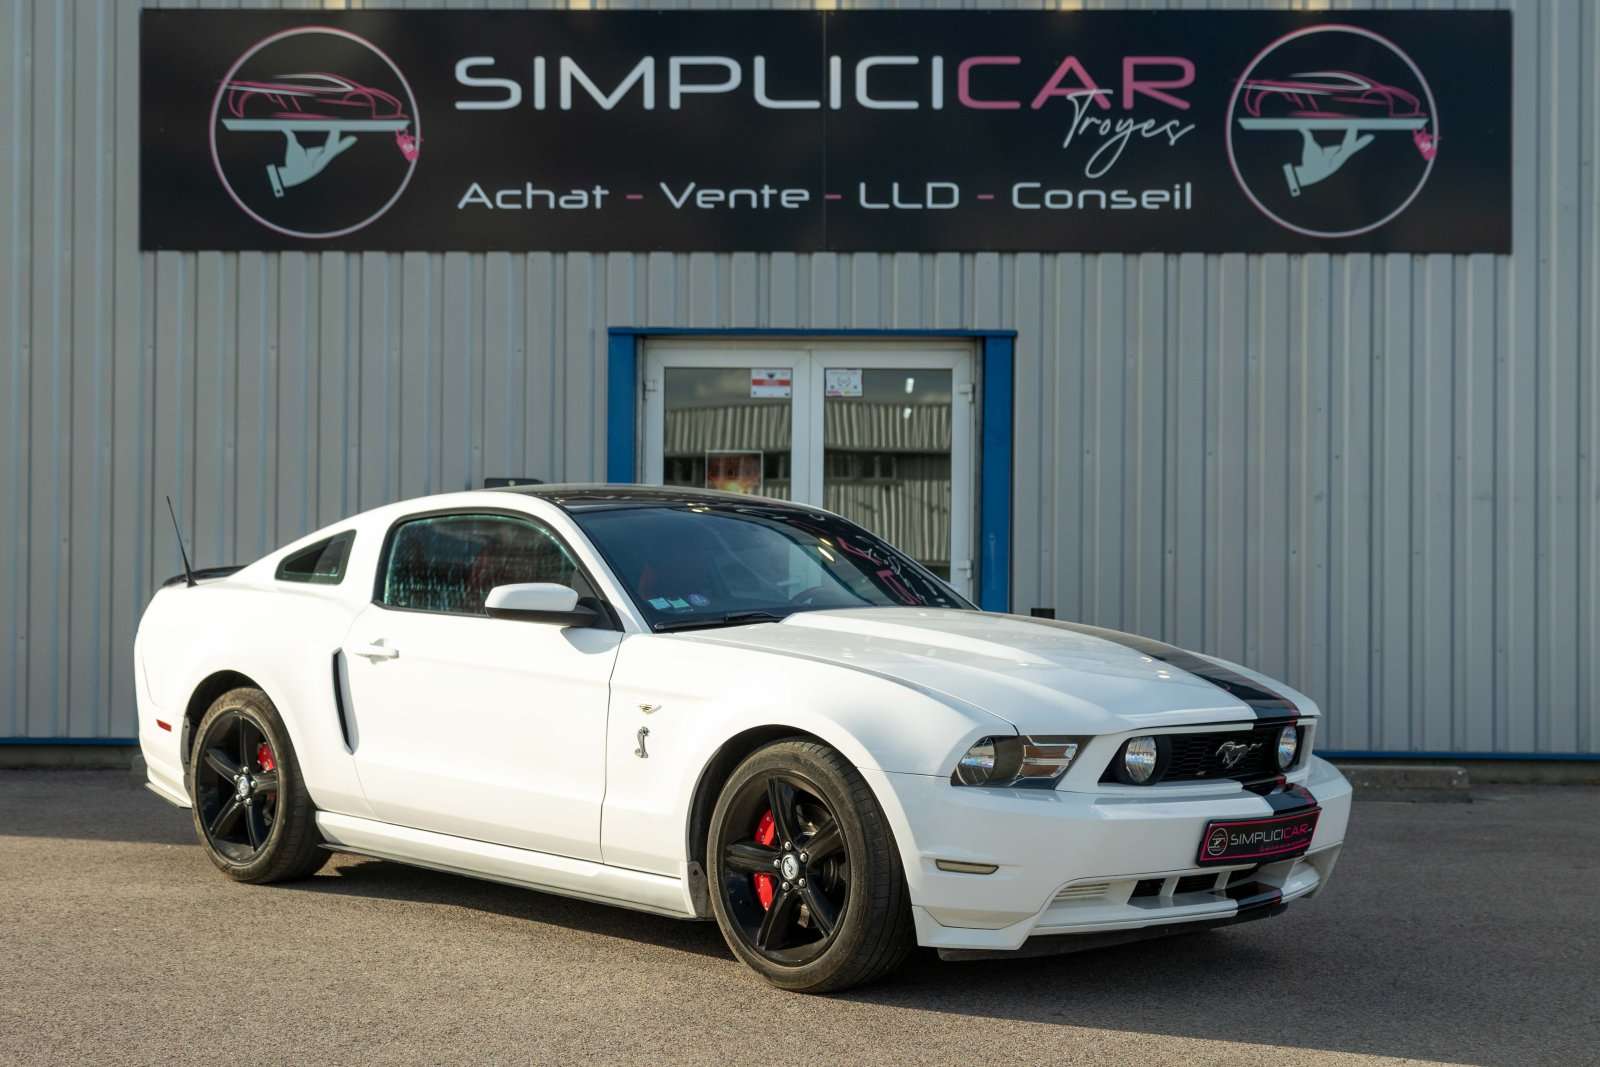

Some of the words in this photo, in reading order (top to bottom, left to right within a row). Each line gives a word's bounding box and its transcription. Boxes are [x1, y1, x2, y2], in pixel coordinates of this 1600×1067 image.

[454, 55, 1196, 110] SIMPLICICAR
[1062, 89, 1195, 178] Troyes
[457, 182, 610, 209] Achat
[659, 182, 811, 209] Vente
[858, 182, 961, 210] LLD
[1011, 182, 1193, 210] Conseil
